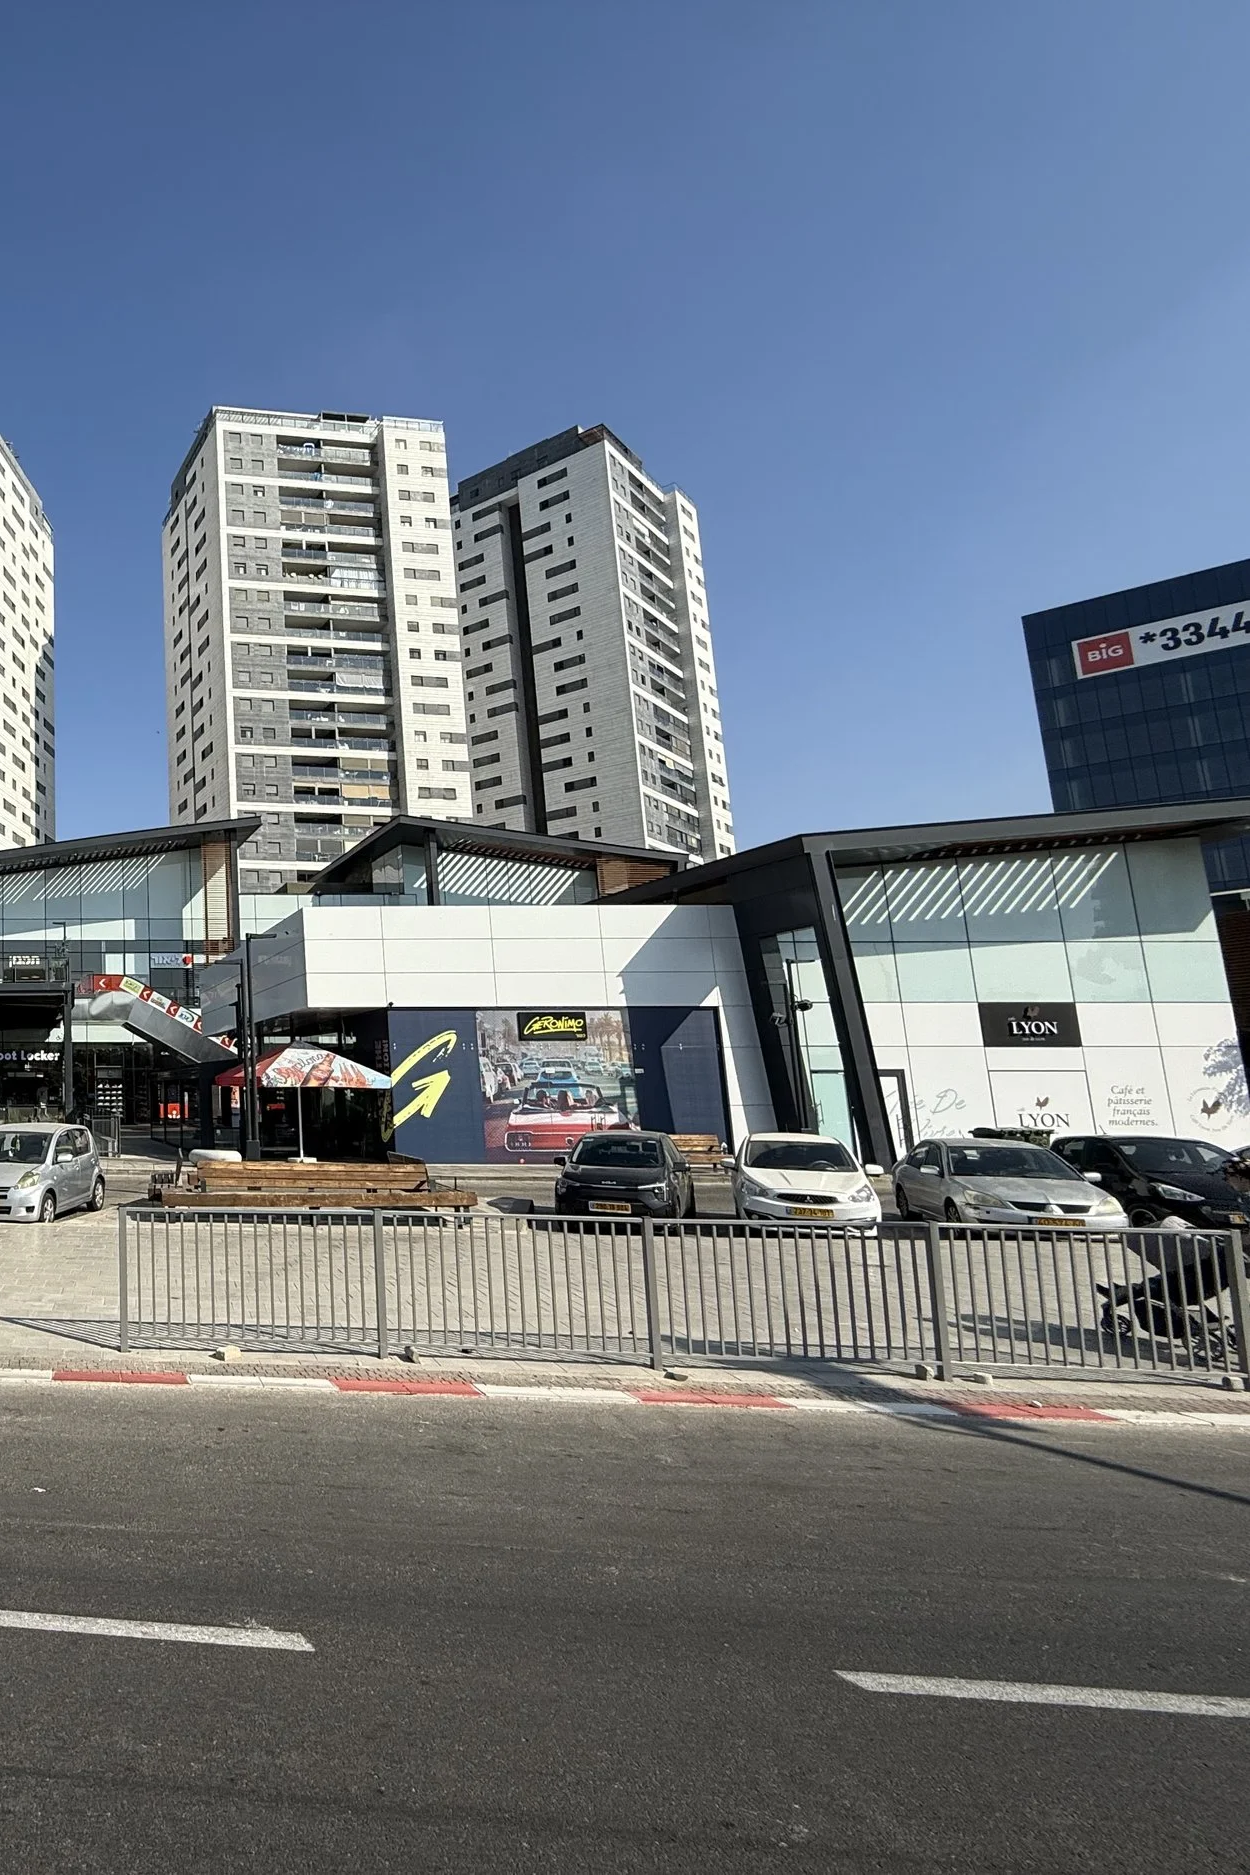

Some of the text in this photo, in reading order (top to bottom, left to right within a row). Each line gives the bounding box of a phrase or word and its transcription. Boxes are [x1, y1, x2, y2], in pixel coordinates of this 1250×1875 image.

[1011, 1021, 1058, 1034] LYON
[21, 1050, 60, 1060] Locker
[1111, 1085, 1145, 1097] Café et
[1018, 1113, 1070, 1128] LYON
[1108, 1116, 1158, 1126] modernes.
